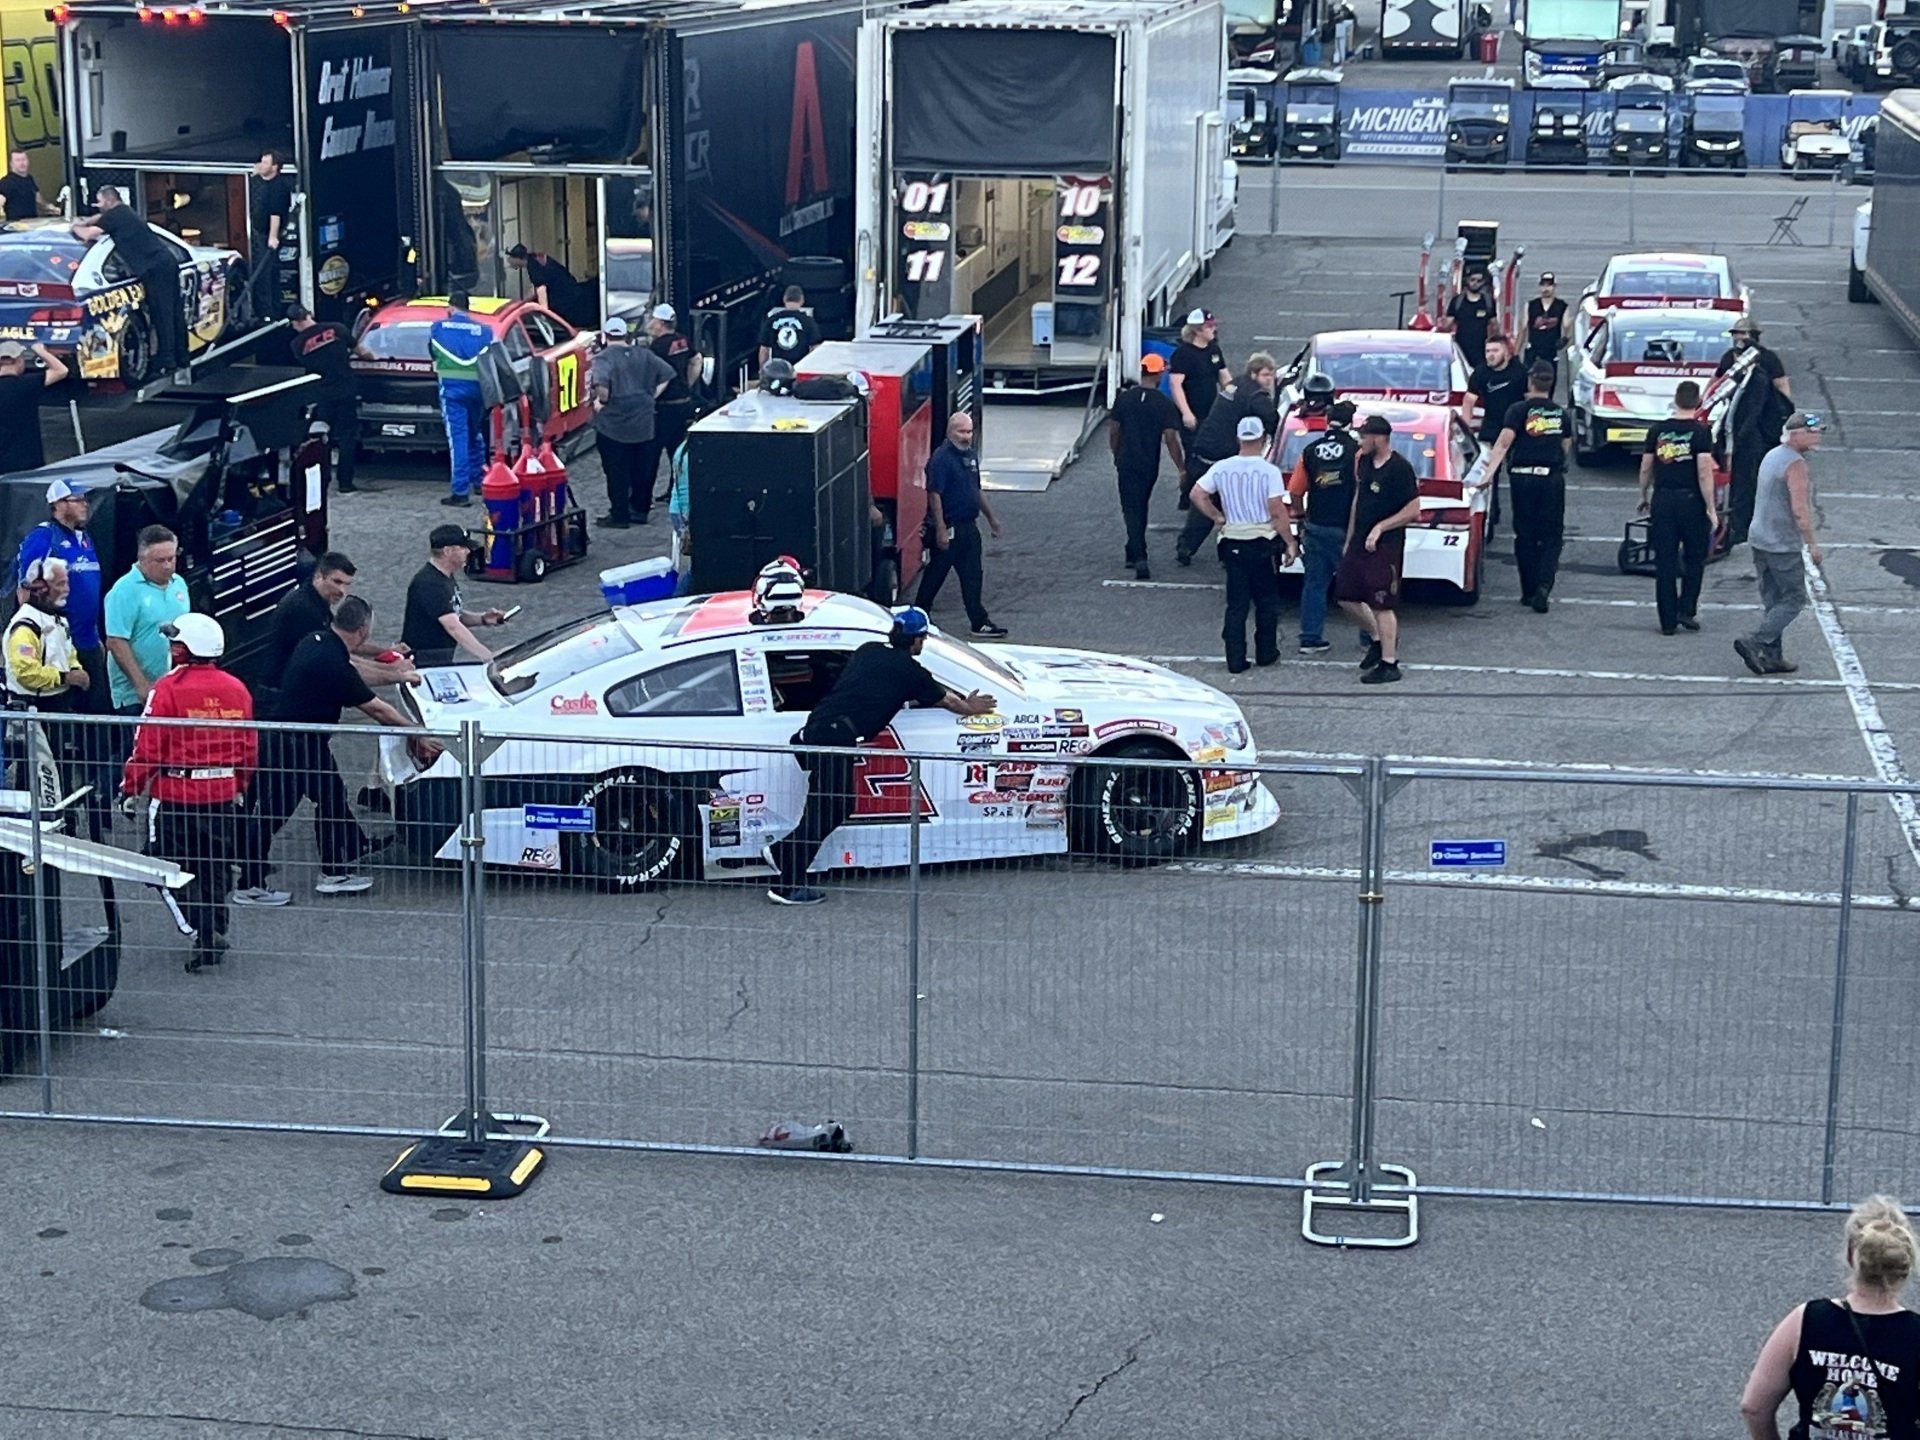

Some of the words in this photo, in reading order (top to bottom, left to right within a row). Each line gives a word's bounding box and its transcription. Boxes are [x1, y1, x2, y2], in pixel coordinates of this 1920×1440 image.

[1348, 107, 1449, 132] MICHIGAN
[902, 181, 949, 213] 01
[1060, 184, 1100, 216] 10
[906, 250, 945, 281] 11
[1058, 254, 1100, 285] 12
[351, 361, 403, 371] GENERAL
[1635, 366, 1690, 376] GENERAL
[1444, 535, 1460, 546] 12
[551, 691, 598, 710] Castle
[1808, 1349, 1900, 1382] WELCOME
[1826, 1367, 1878, 1389] HOME
